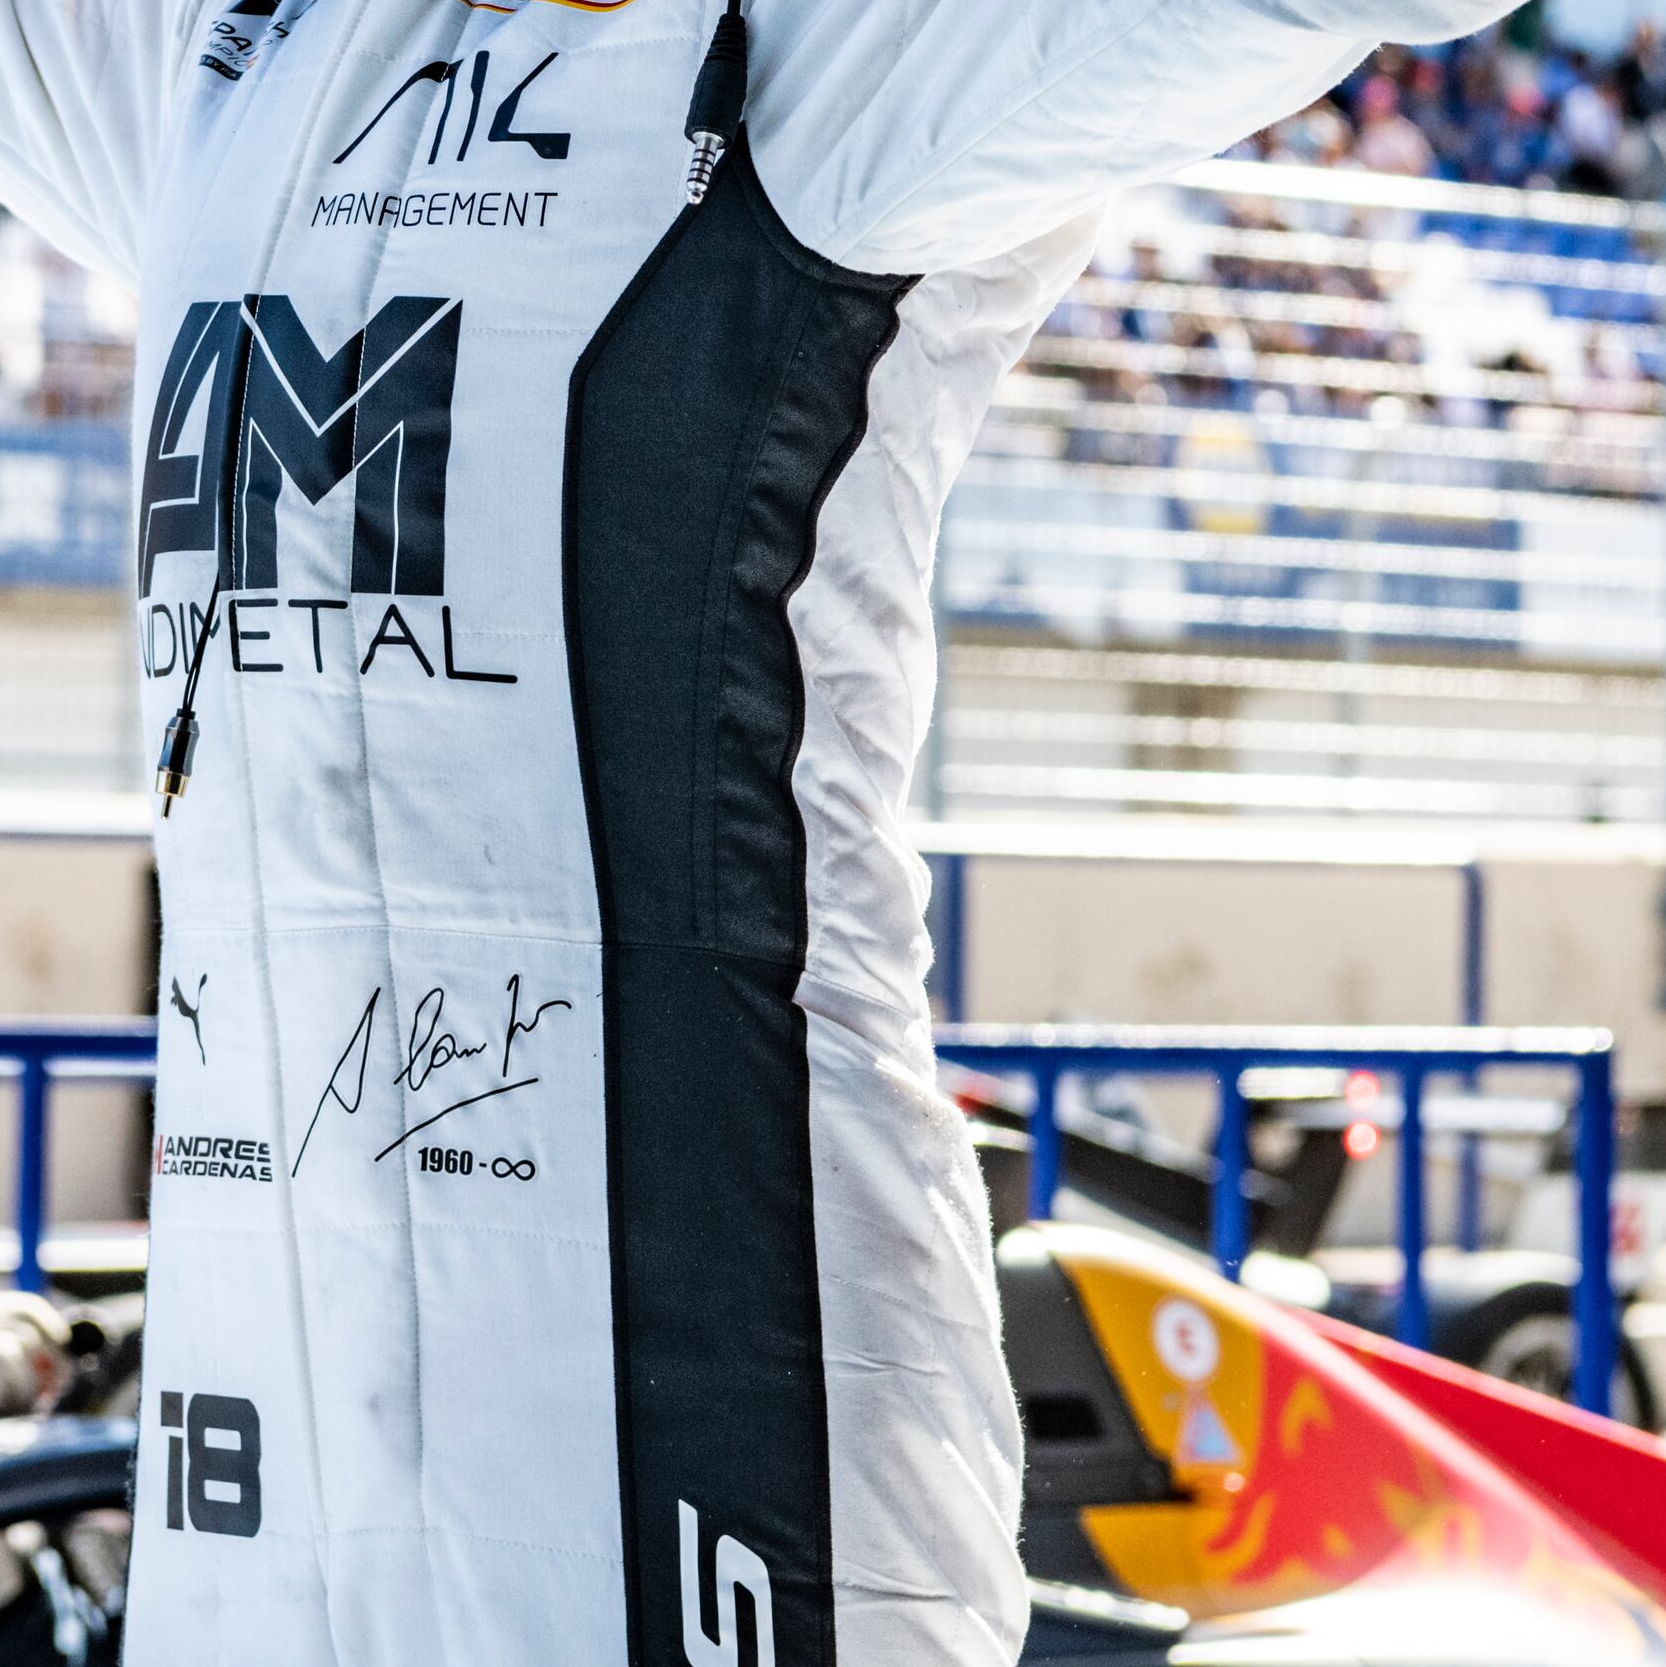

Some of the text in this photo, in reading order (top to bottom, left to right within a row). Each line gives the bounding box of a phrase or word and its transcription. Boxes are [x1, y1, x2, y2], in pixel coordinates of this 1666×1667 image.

[310, 191, 559, 229] MANAGEMENT
[163, 1135, 272, 1164] ANDRES
[161, 1159, 274, 1183] CARDENAS
